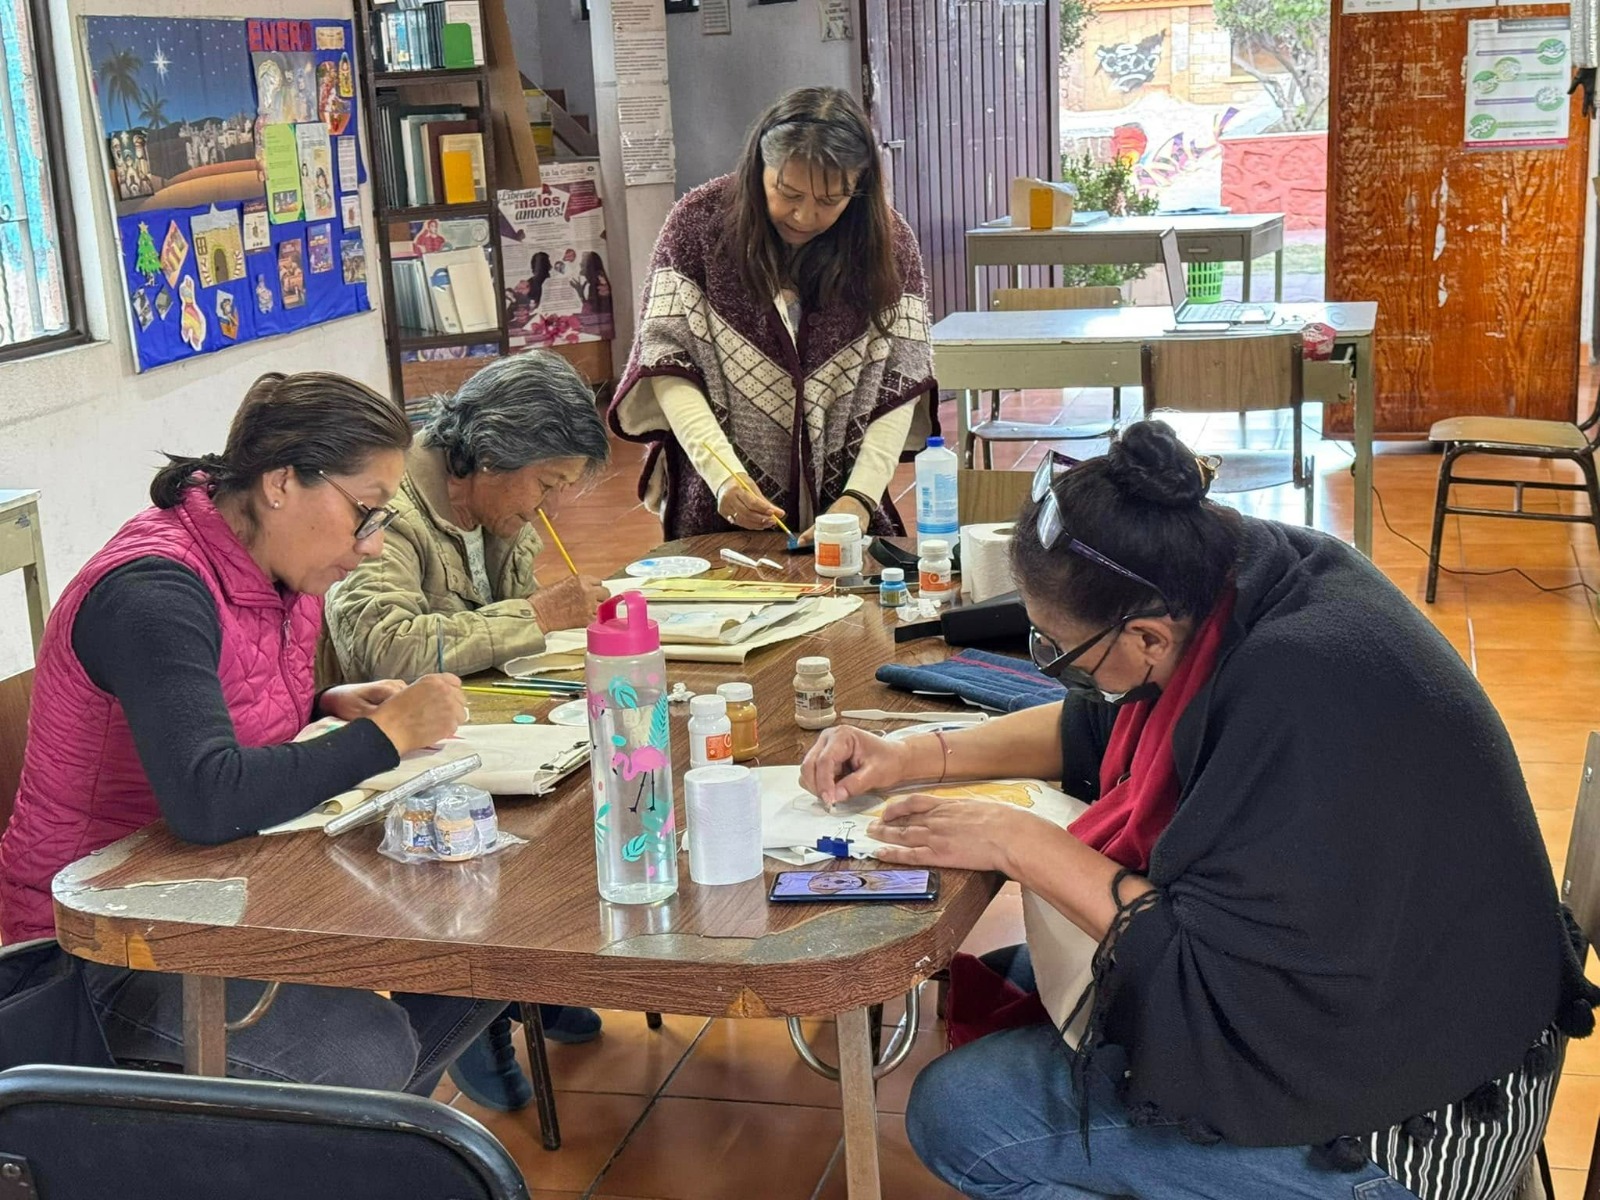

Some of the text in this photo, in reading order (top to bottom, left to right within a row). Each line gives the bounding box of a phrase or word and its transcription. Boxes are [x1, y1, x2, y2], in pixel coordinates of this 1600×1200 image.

[247, 20, 313, 51] ENERO
[515, 194, 561, 209] malos
[515, 201, 566, 221] amores!
